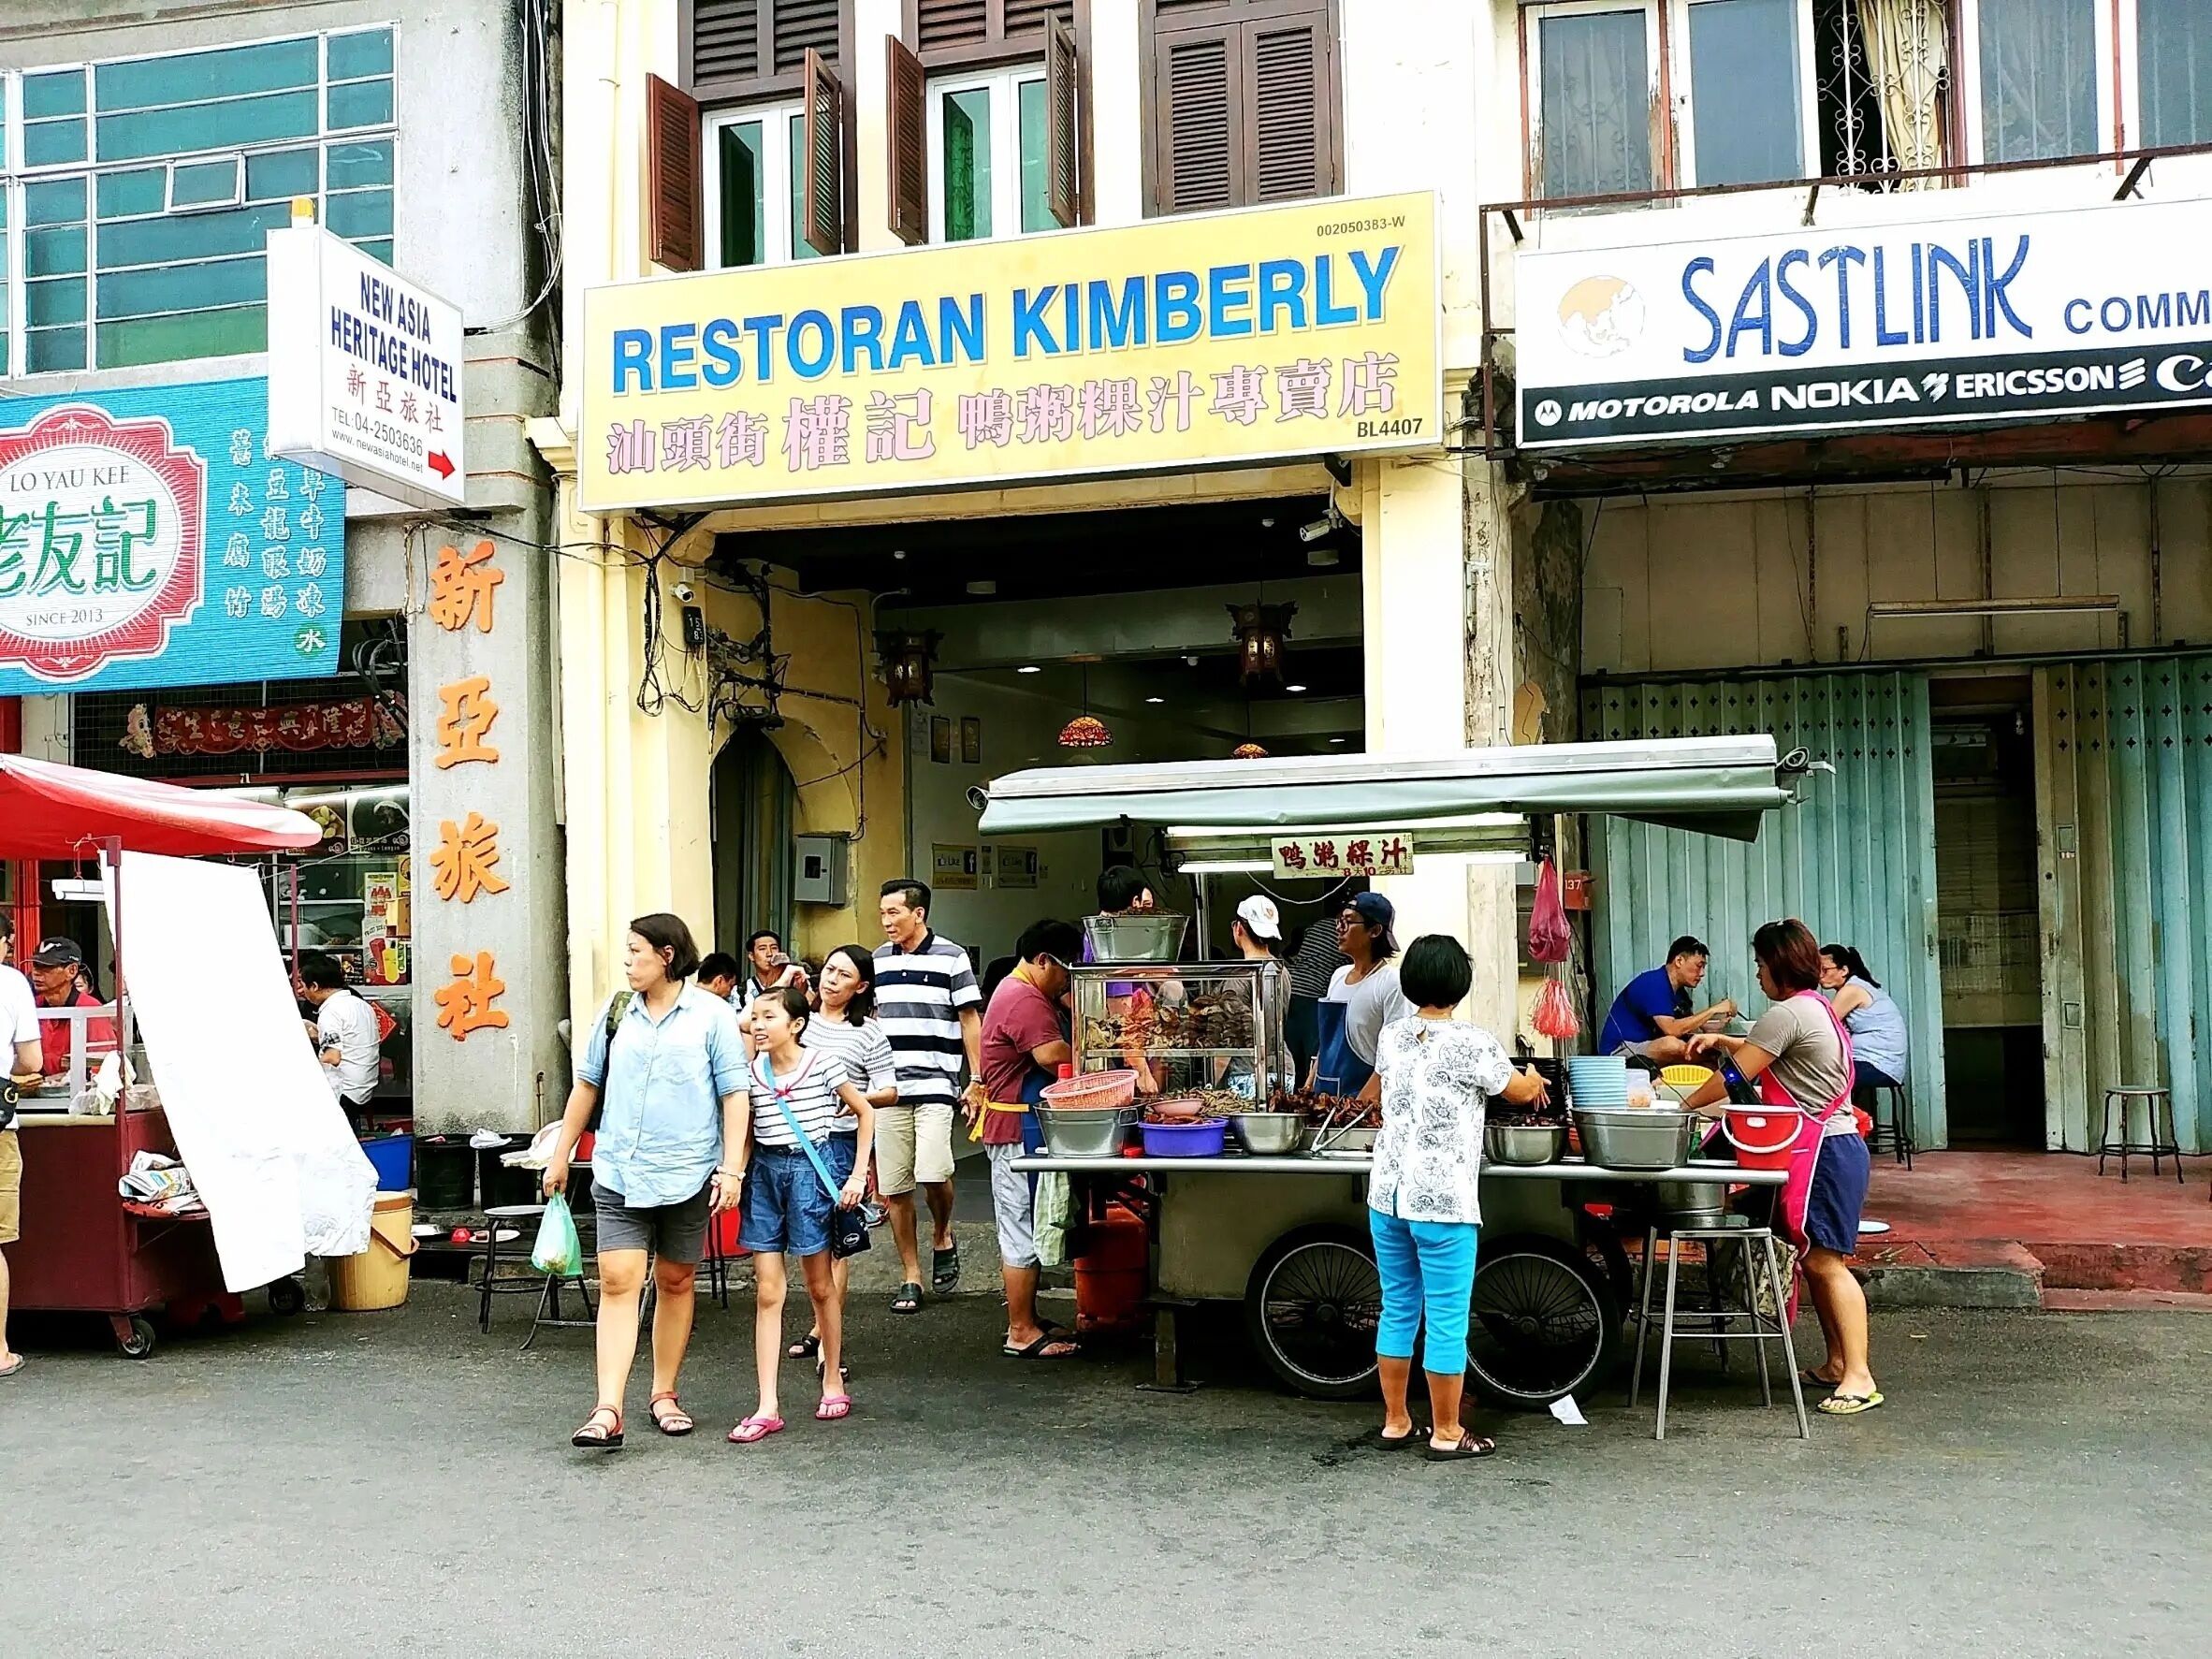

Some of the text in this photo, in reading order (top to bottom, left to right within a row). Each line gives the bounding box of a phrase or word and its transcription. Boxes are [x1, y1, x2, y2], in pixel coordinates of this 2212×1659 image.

[1317, 215, 1405, 238] 002050383-W
[360, 270, 431, 345] NEW ASIA
[613, 246, 1400, 394] RESTORAN KIMBERLY
[1681, 235, 2210, 363] SASTLINK COMM
[331, 305, 457, 403] HERITAGE HOTEL
[347, 363, 444, 434] 新亞旅社
[1357, 417, 1423, 439] BL4407
[1567, 389, 1759, 422] MOTOROLA
[1771, 377, 1920, 411] NOKIA
[1956, 364, 2115, 399] ERICSSON
[607, 410, 769, 475] 汕頭街
[782, 387, 937, 472] 權記
[11, 465, 130, 492] LO YAU KEE
[26, 608, 104, 626] SINCE 2013
[429, 540, 509, 1041] 新亞旅社
[1564, 879, 1581, 891] 137
